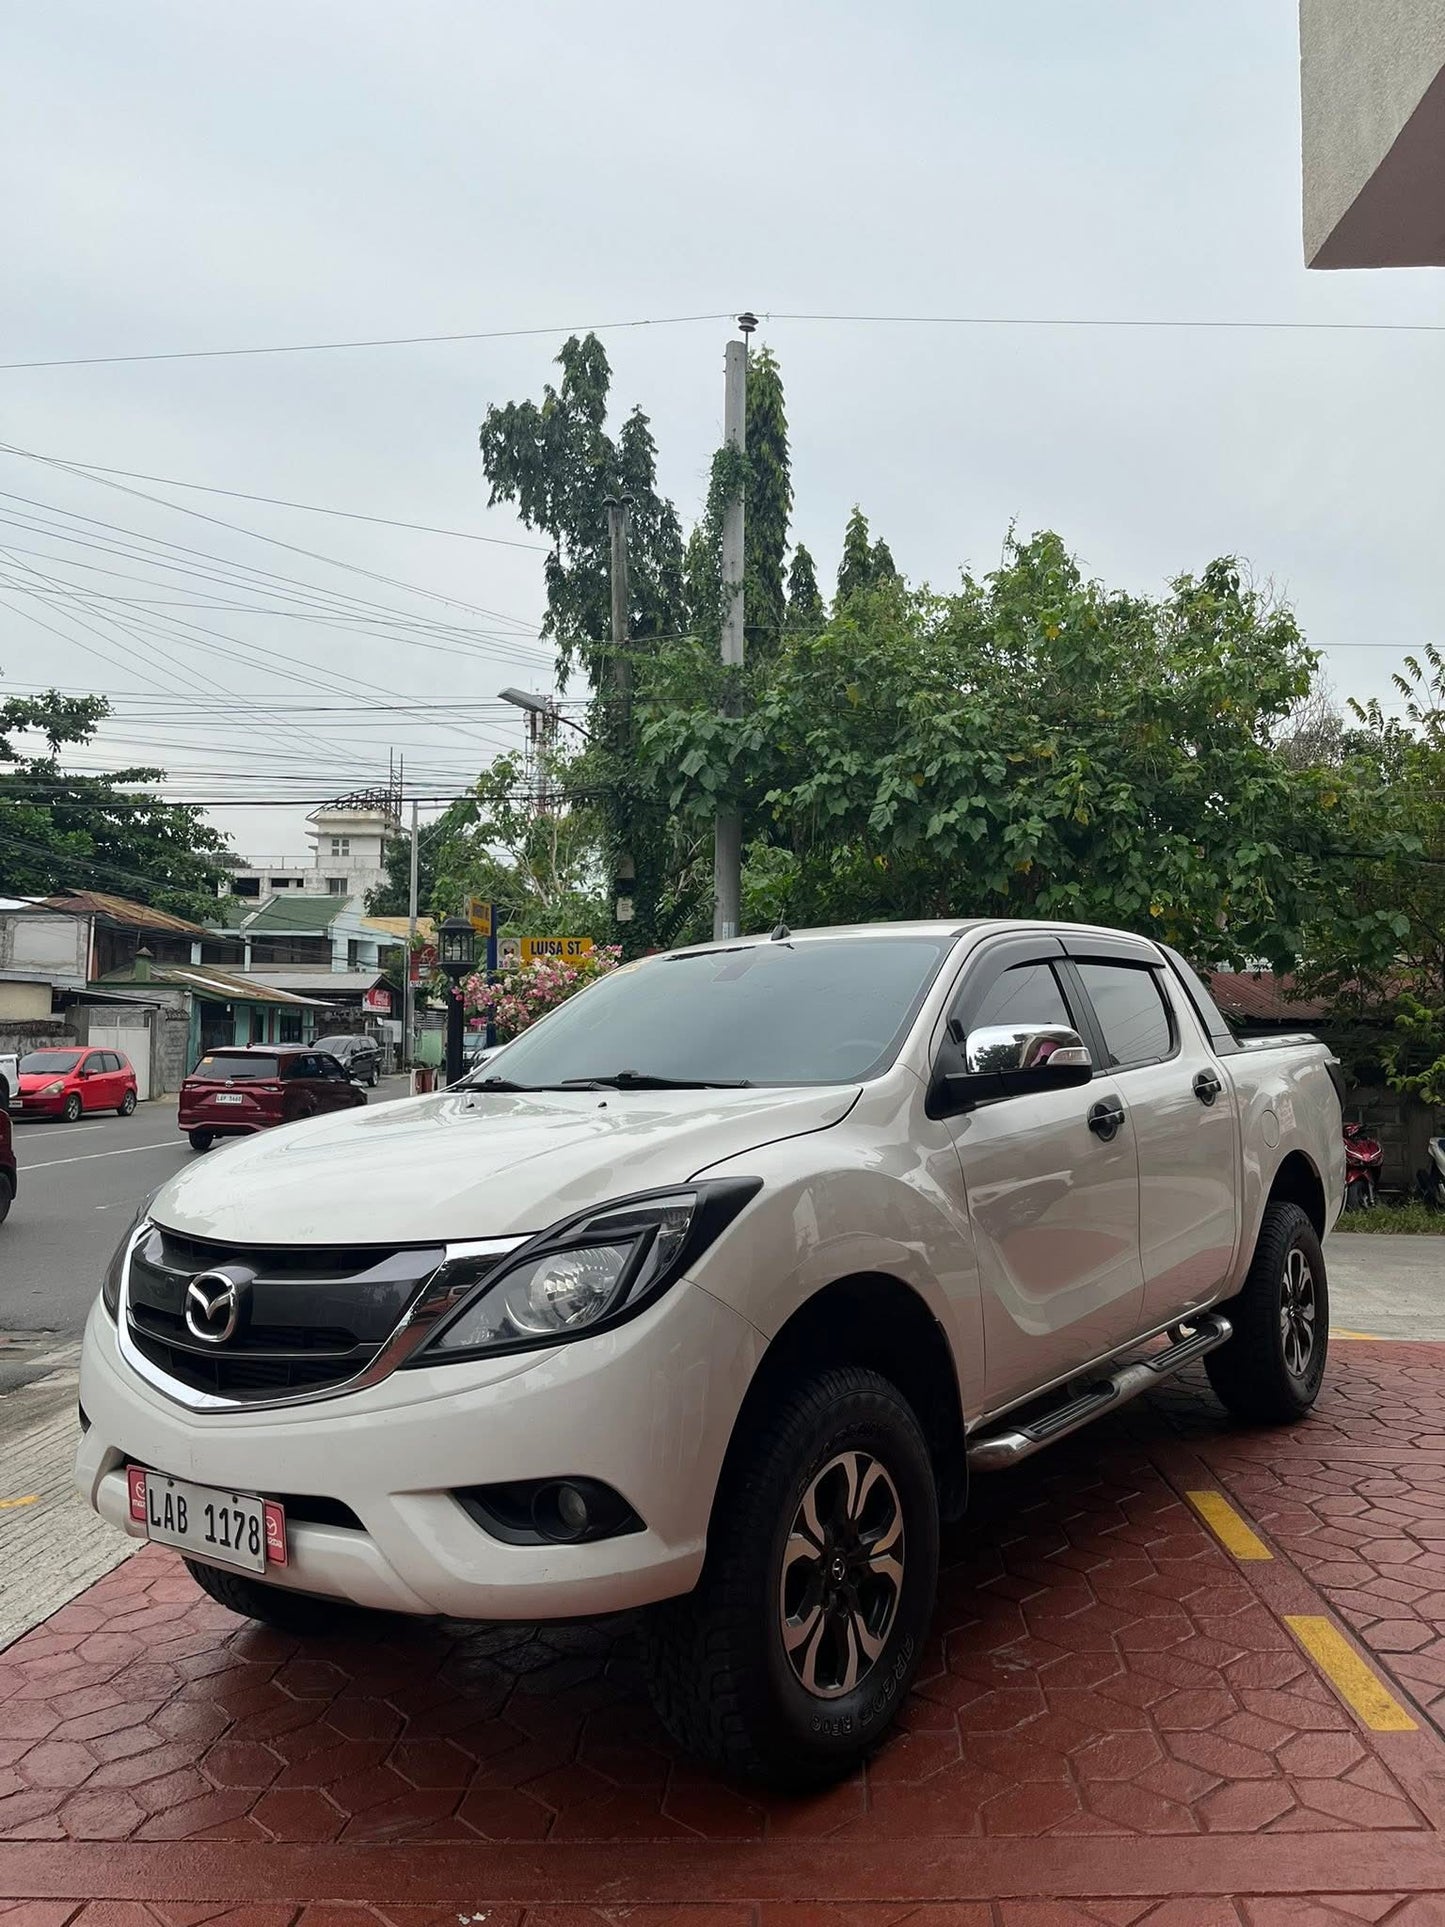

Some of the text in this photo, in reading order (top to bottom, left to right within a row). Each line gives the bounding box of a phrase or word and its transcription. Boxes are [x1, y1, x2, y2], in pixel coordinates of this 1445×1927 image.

[530, 940, 583, 956] LUISA ST.
[149, 1489, 260, 1556] LAB 1178
